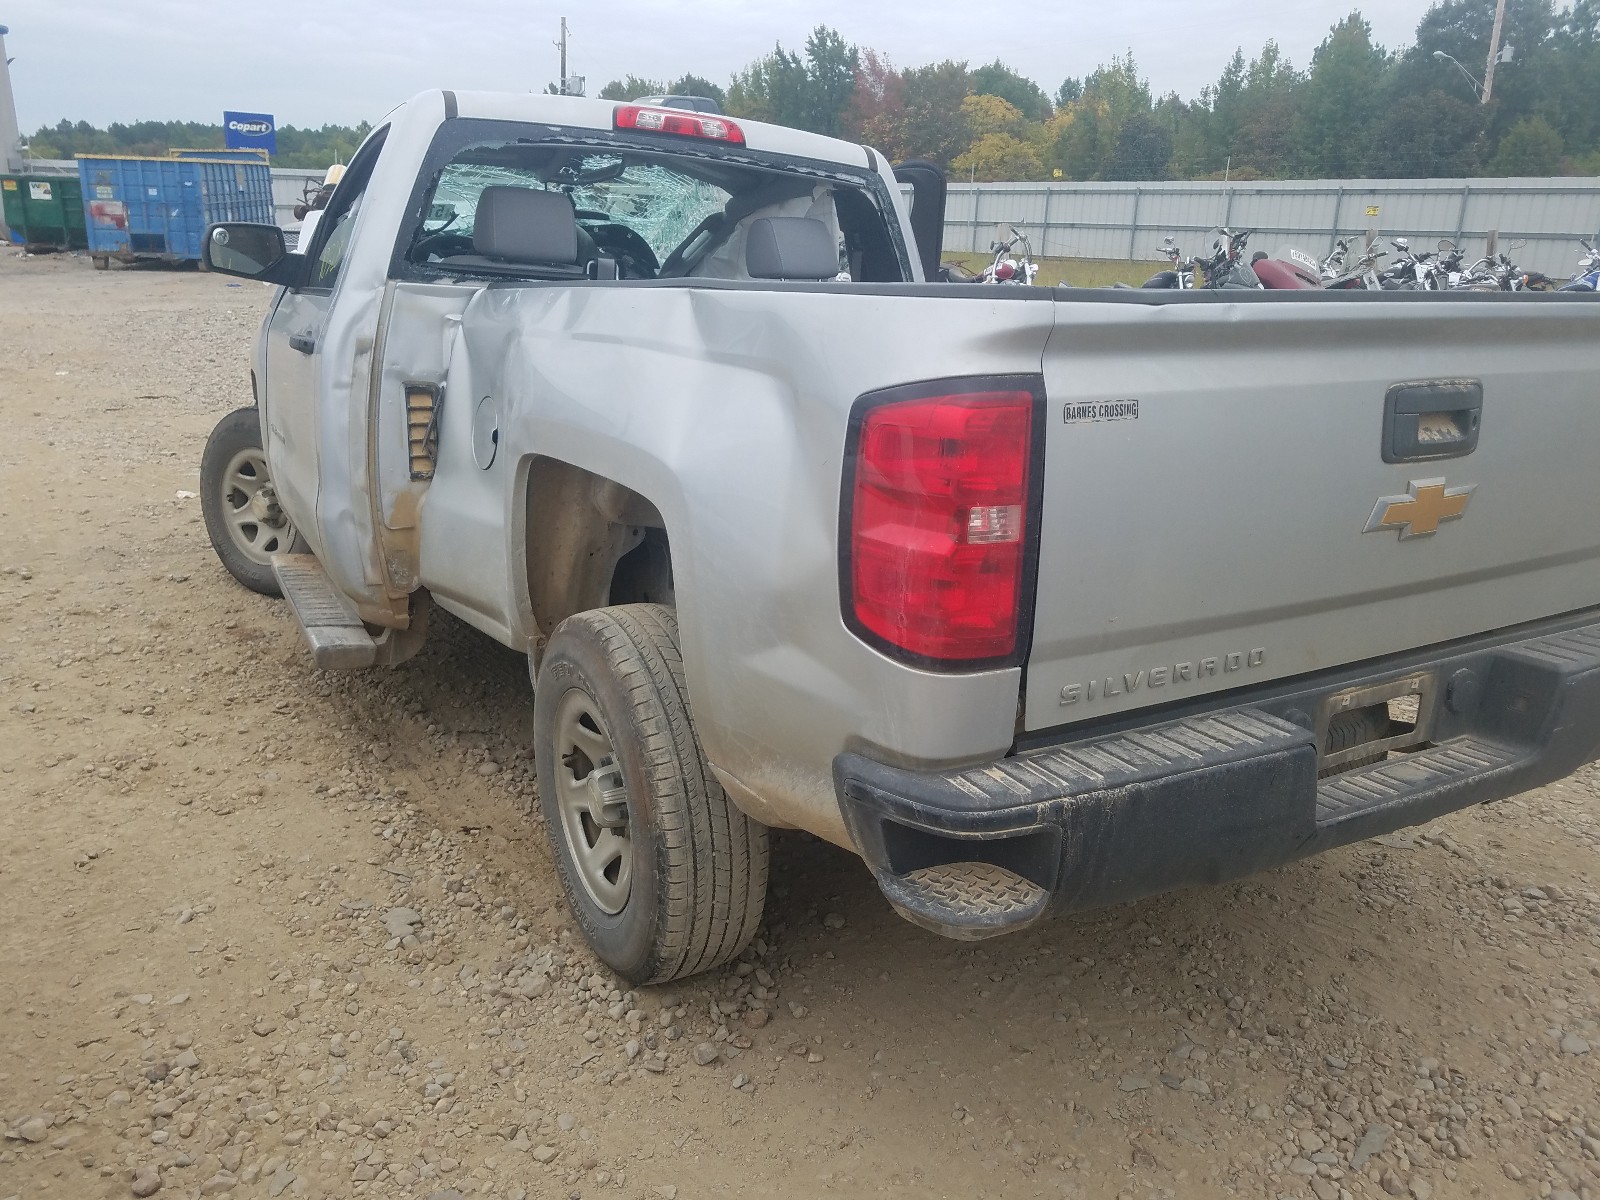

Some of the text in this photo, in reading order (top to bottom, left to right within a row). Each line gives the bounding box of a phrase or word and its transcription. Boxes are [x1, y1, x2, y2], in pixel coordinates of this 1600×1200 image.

[229, 120, 267, 132] Copart
[1066, 403, 1137, 420] BARNES CROSSING
[1059, 647, 1266, 707] SILVERADO
